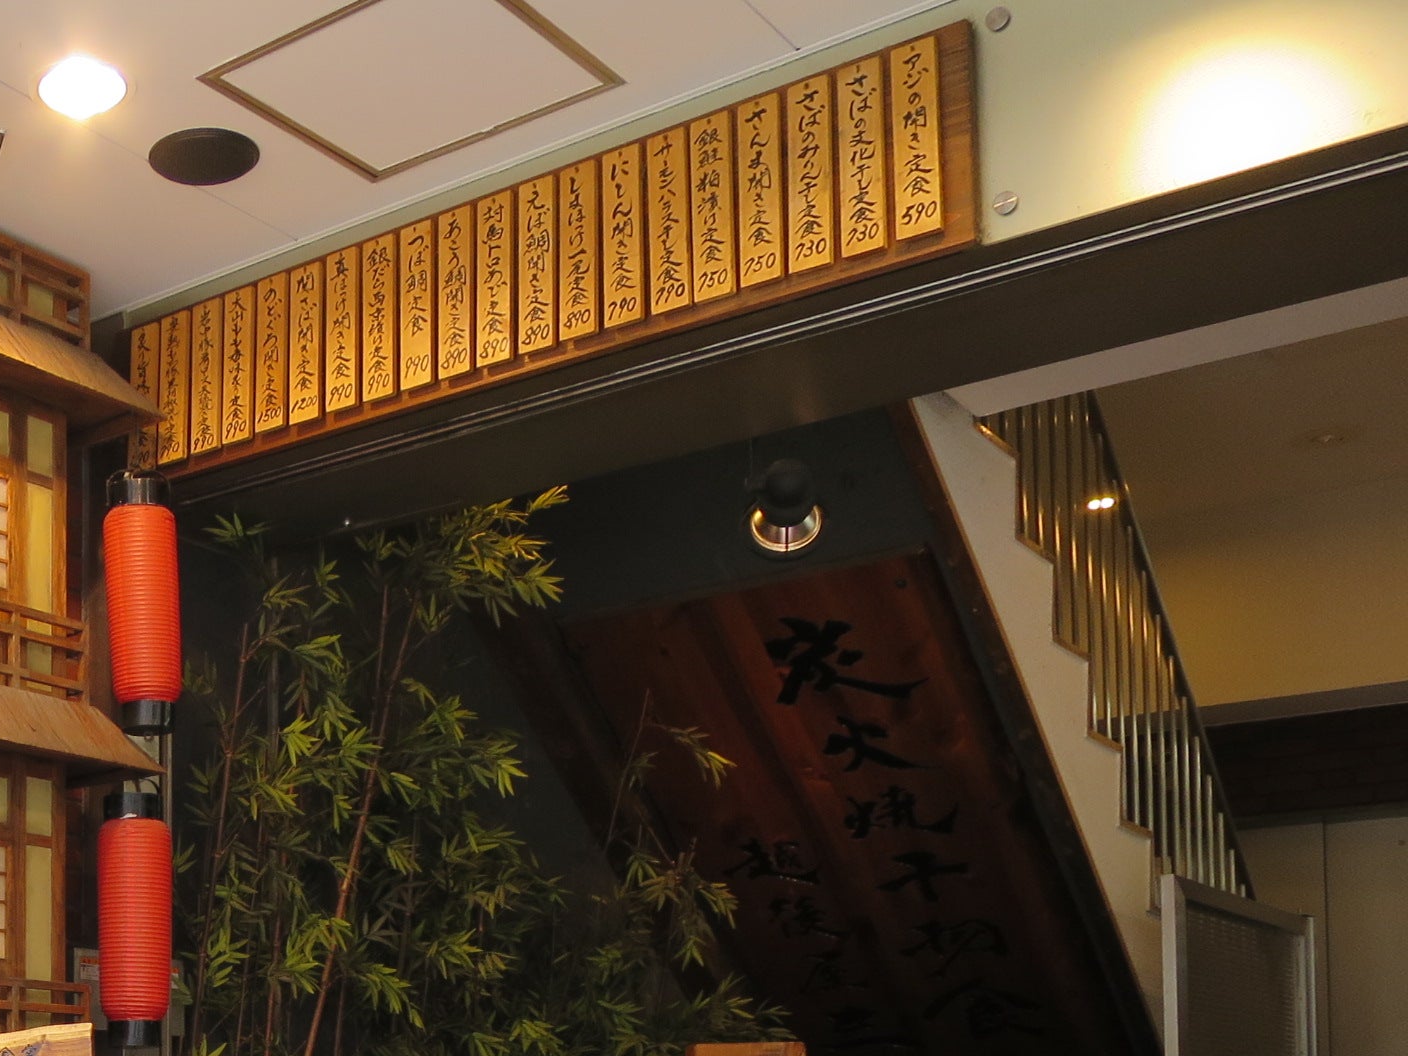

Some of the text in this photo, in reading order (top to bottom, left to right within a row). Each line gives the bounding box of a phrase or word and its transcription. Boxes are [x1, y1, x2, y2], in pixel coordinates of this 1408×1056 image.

[901, 53, 937, 226] アジの開き定食 590
[845, 74, 879, 247] さばの文化干し定食 730
[795, 86, 827, 262] さばのみりん干し定食 730
[744, 107, 776, 277] さんま開き定食 750
[608, 159, 637, 321] にしん開き定食 790
[698, 268, 728, 293] 750
[655, 282, 685, 306] 790
[563, 309, 591, 330] 890
[521, 324, 550, 346] 890
[441, 348, 467, 370] 890
[479, 336, 508, 359] 890
[404, 353, 429, 379] 990
[328, 382, 353, 406] 990
[367, 373, 390, 395] 990
[257, 406, 282, 424] 1500
[291, 395, 318, 414] 1200
[224, 419, 247, 440] 990
[193, 434, 214, 451] 990
